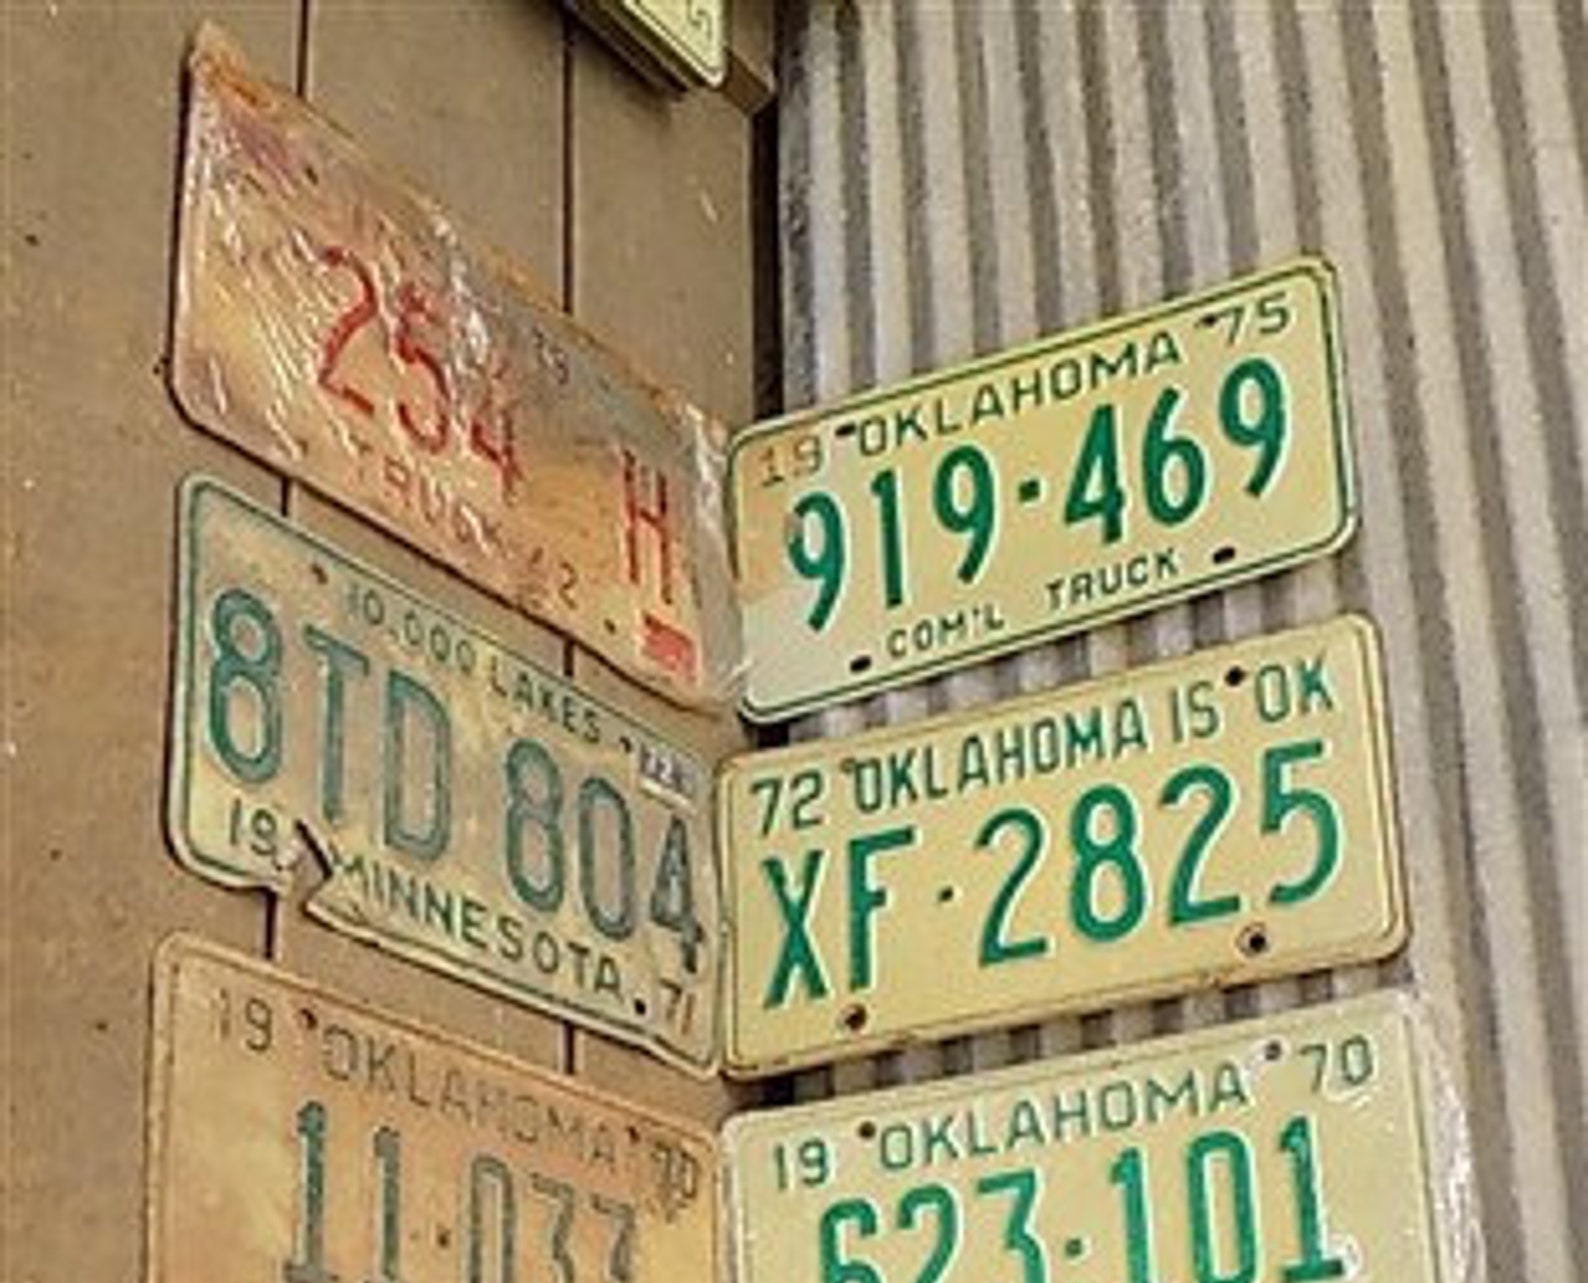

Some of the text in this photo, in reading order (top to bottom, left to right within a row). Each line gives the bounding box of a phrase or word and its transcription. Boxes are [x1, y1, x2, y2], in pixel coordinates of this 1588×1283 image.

[316, 245, 673, 605] 254 H
[760, 293, 1291, 488] 19 OKLAHOMA 75
[1044, 547, 1181, 612] TRUCK
[207, 587, 702, 975] 8TD 804
[490, 653, 602, 746] LAKES
[751, 770, 825, 837] 72
[852, 699, 1148, 815] OKLAHOMA
[1171, 680, 1221, 743] IS
[1254, 655, 1334, 724] OK
[229, 797, 276, 857] 19
[328, 840, 622, 996] MINNESOTA
[217, 988, 274, 1052] 19
[322, 1023, 618, 1174] OKLAHOMA
[774, 1033, 1375, 1192] 19 OKLAHOMA 70
